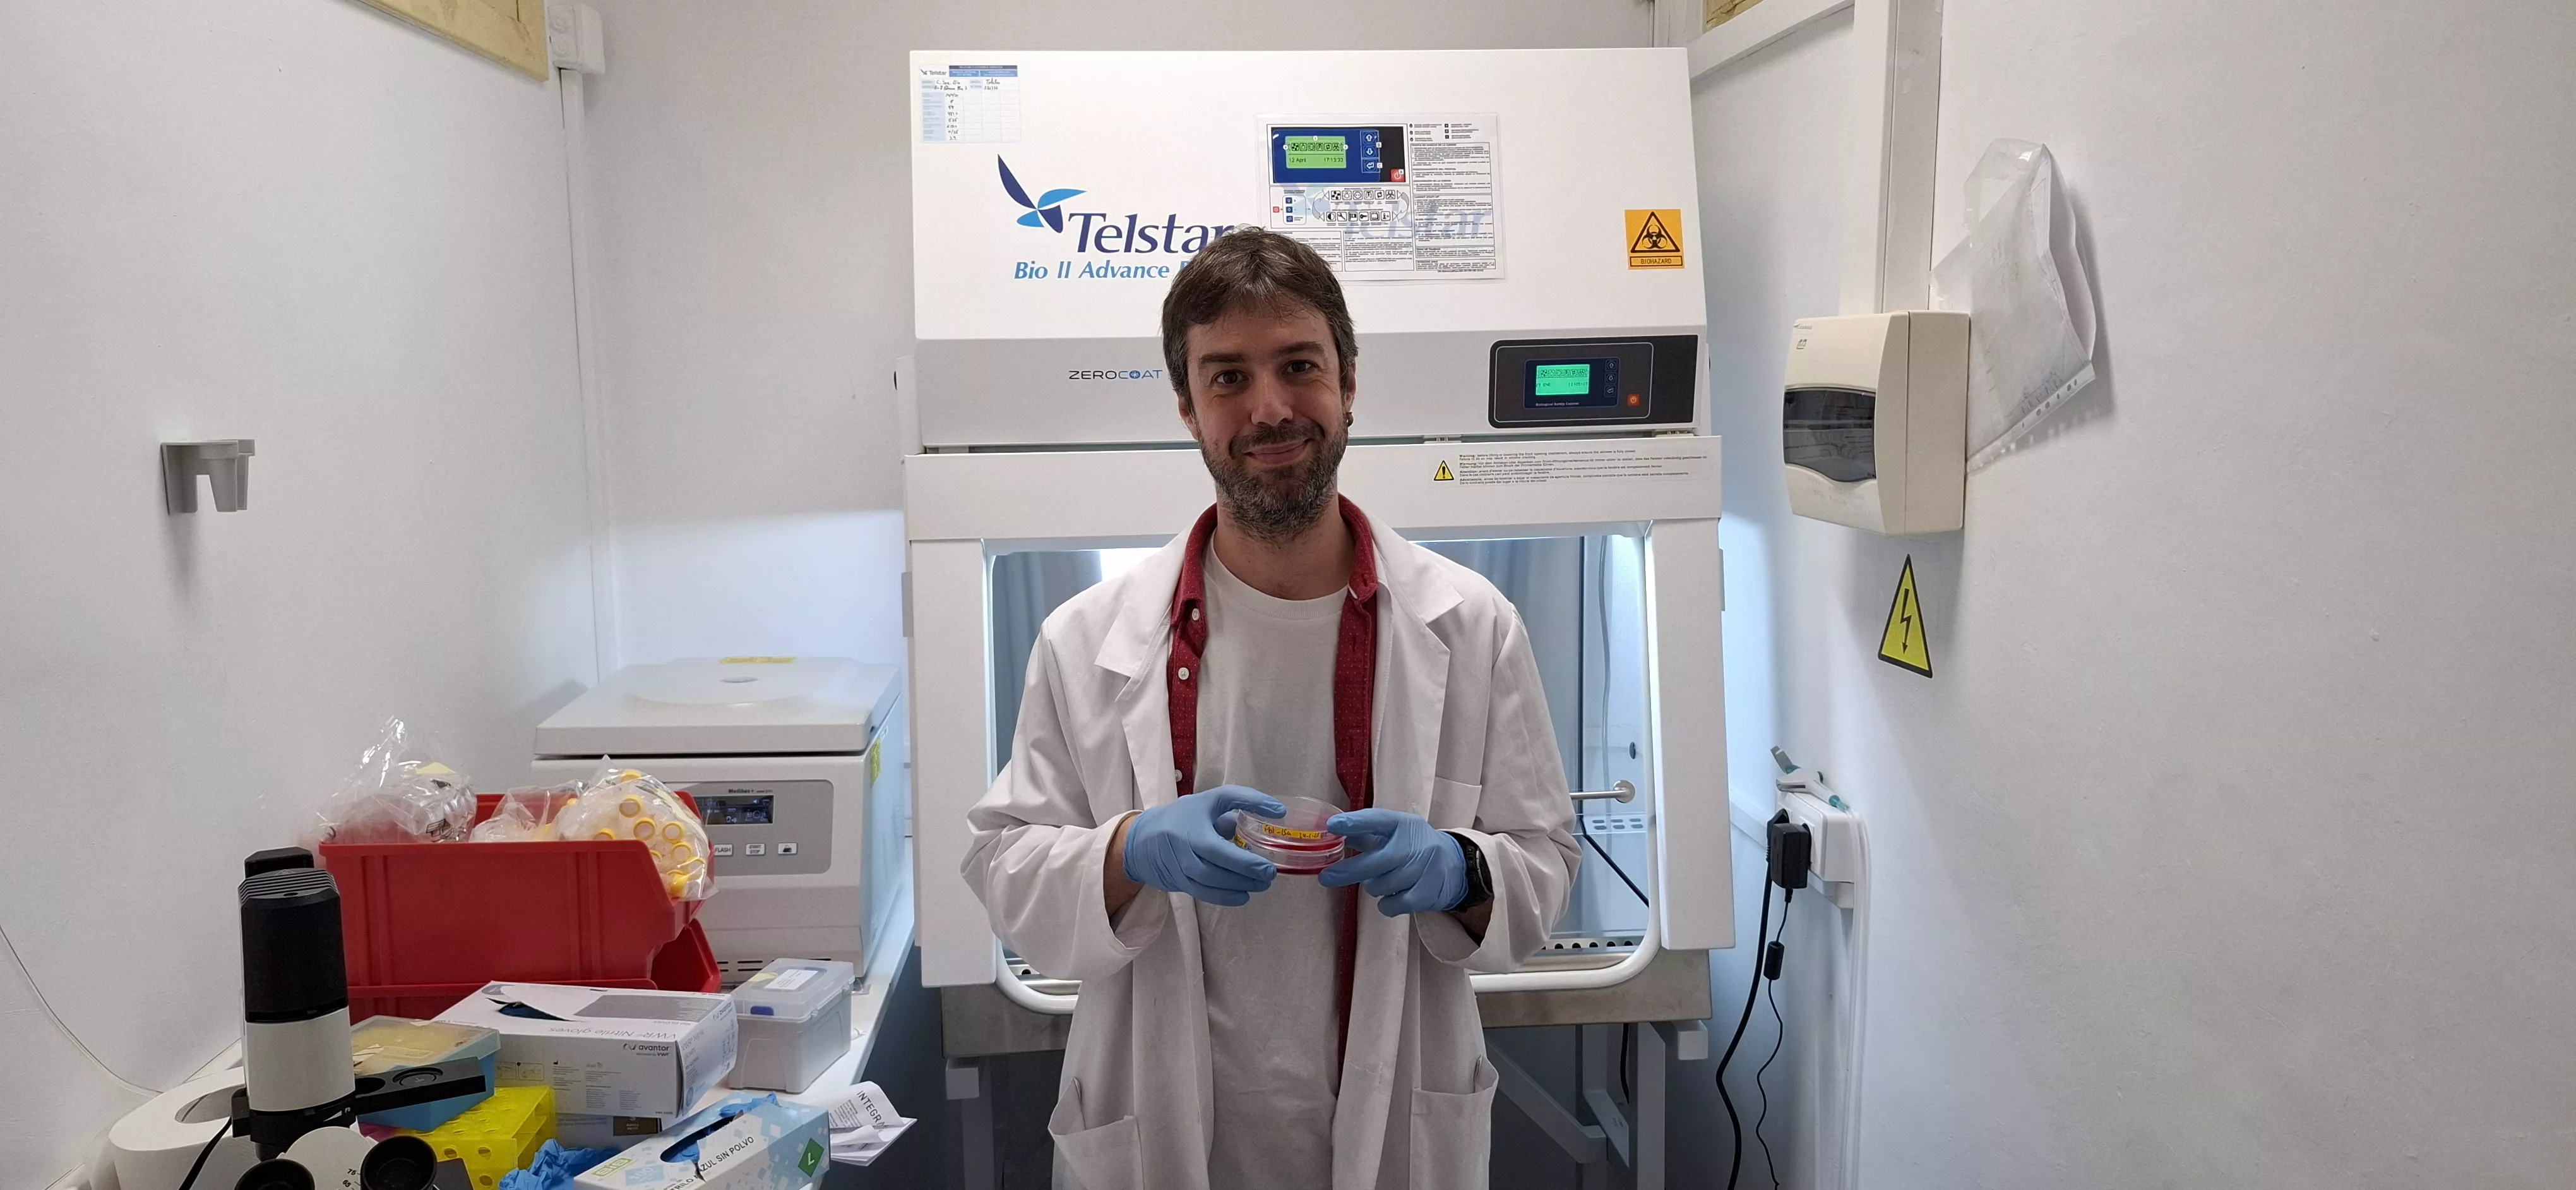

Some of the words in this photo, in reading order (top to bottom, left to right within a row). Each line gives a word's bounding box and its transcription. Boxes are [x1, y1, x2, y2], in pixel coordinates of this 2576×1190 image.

[1068, 213, 1234, 253] Telstar
[1014, 260, 1048, 279] Bio
[1078, 260, 1170, 279] Advance
[1069, 370, 1162, 379] ZEROCOAT
[716, 1152, 730, 1163] SIN
[729, 1136, 754, 1155] POLVO
[342, 1179, 352, 1187] 65
